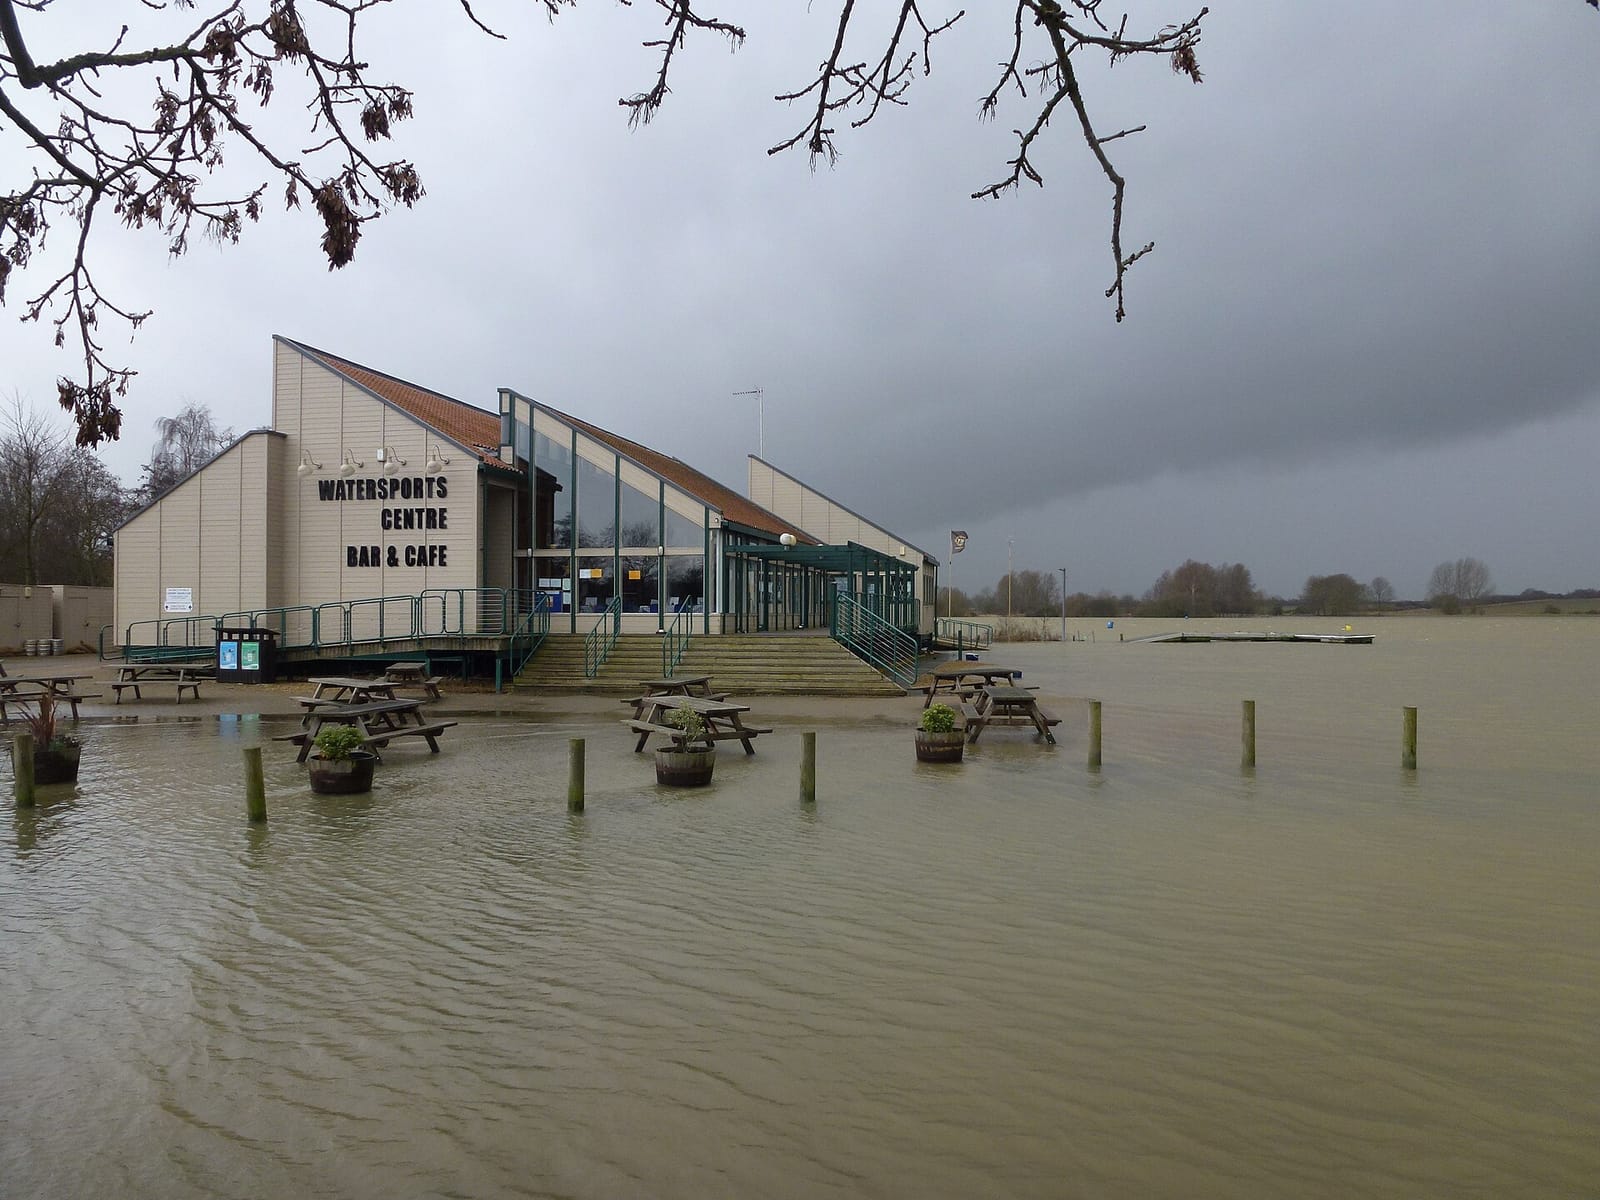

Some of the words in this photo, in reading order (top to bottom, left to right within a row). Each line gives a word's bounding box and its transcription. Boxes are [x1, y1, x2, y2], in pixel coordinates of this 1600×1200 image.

[318, 476, 448, 501] WATERSPORTS
[381, 508, 448, 530] CENTRE
[347, 546, 381, 567] BAR
[386, 546, 399, 567] &
[404, 545, 447, 567] CAFE
